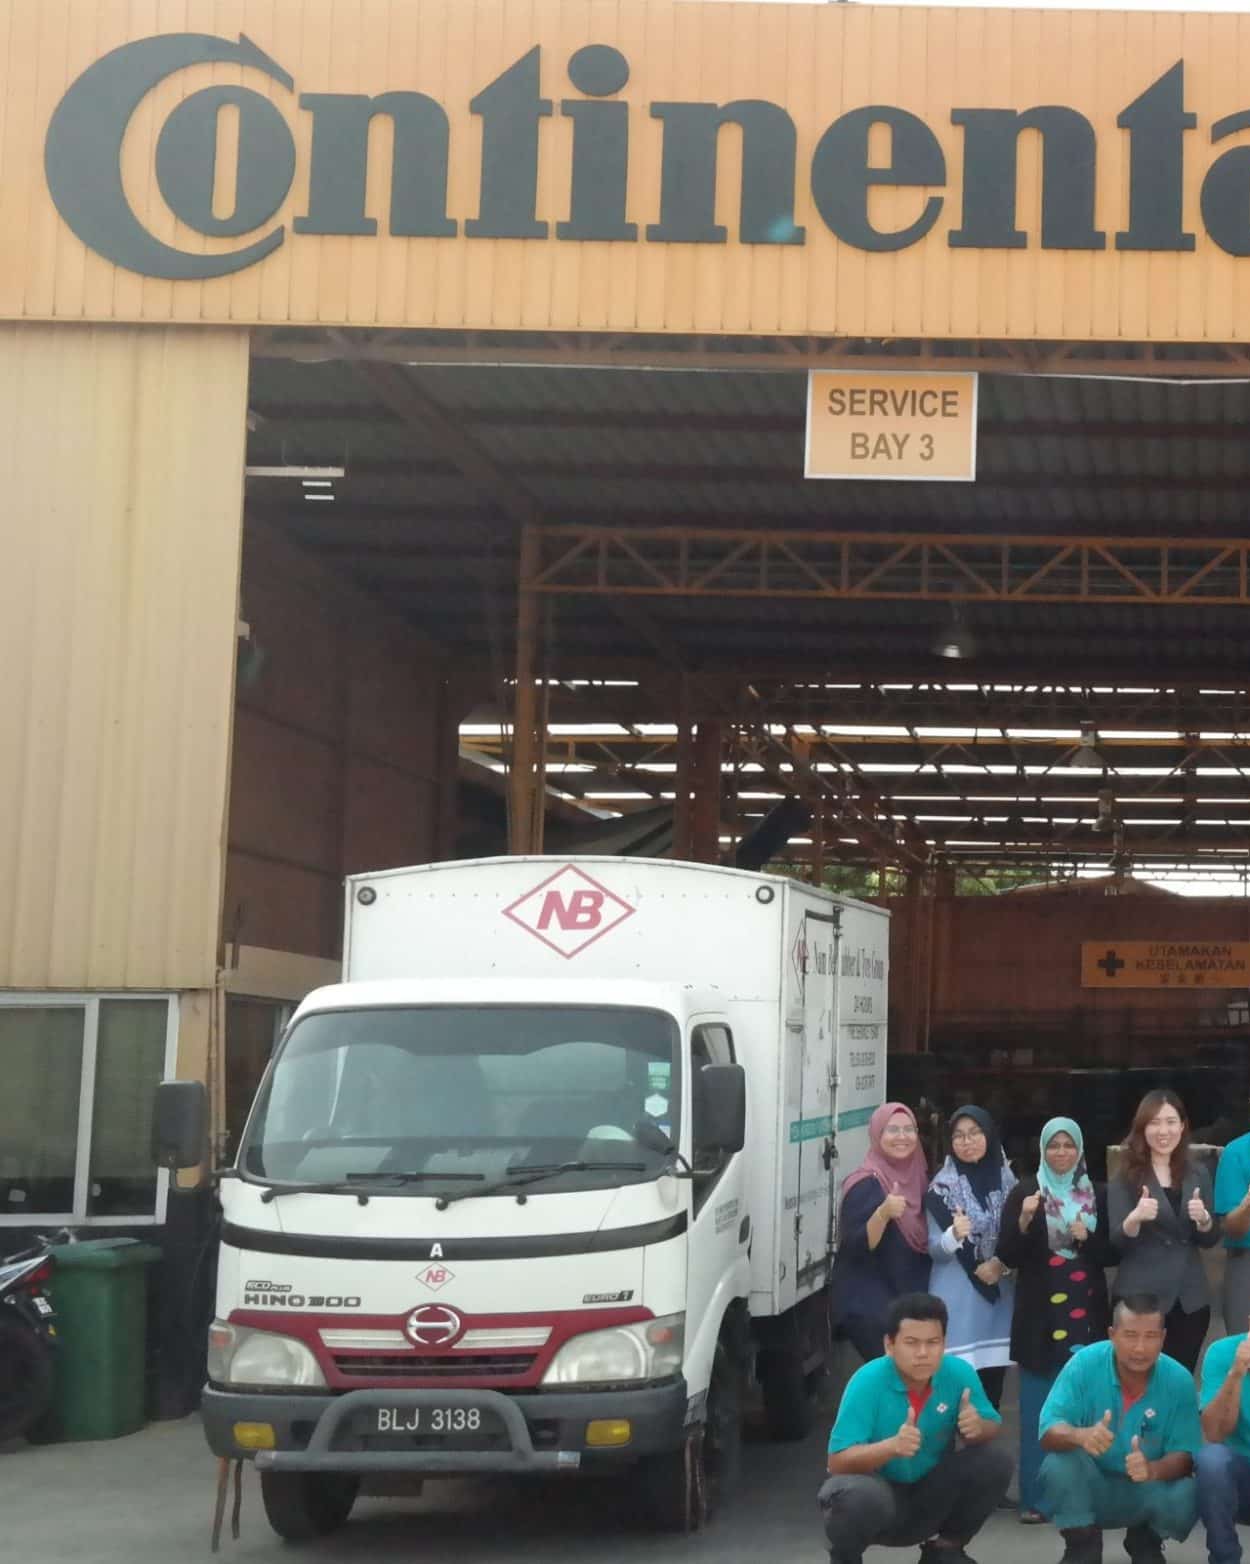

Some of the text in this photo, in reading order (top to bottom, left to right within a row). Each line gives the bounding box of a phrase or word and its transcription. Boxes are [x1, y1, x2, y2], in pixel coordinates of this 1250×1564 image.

[827, 387, 960, 418] SERVICE
[850, 432, 935, 461] BAY 3
[535, 889, 605, 931] NB
[1149, 945, 1232, 957] UTAMAKAN
[1135, 959, 1246, 971] KESELAMATAN
[429, 1243, 443, 1259] A
[425, 1270, 446, 1283] NB
[244, 1294, 362, 1307] HINO 300
[377, 1407, 481, 1432] BLJ 3138
